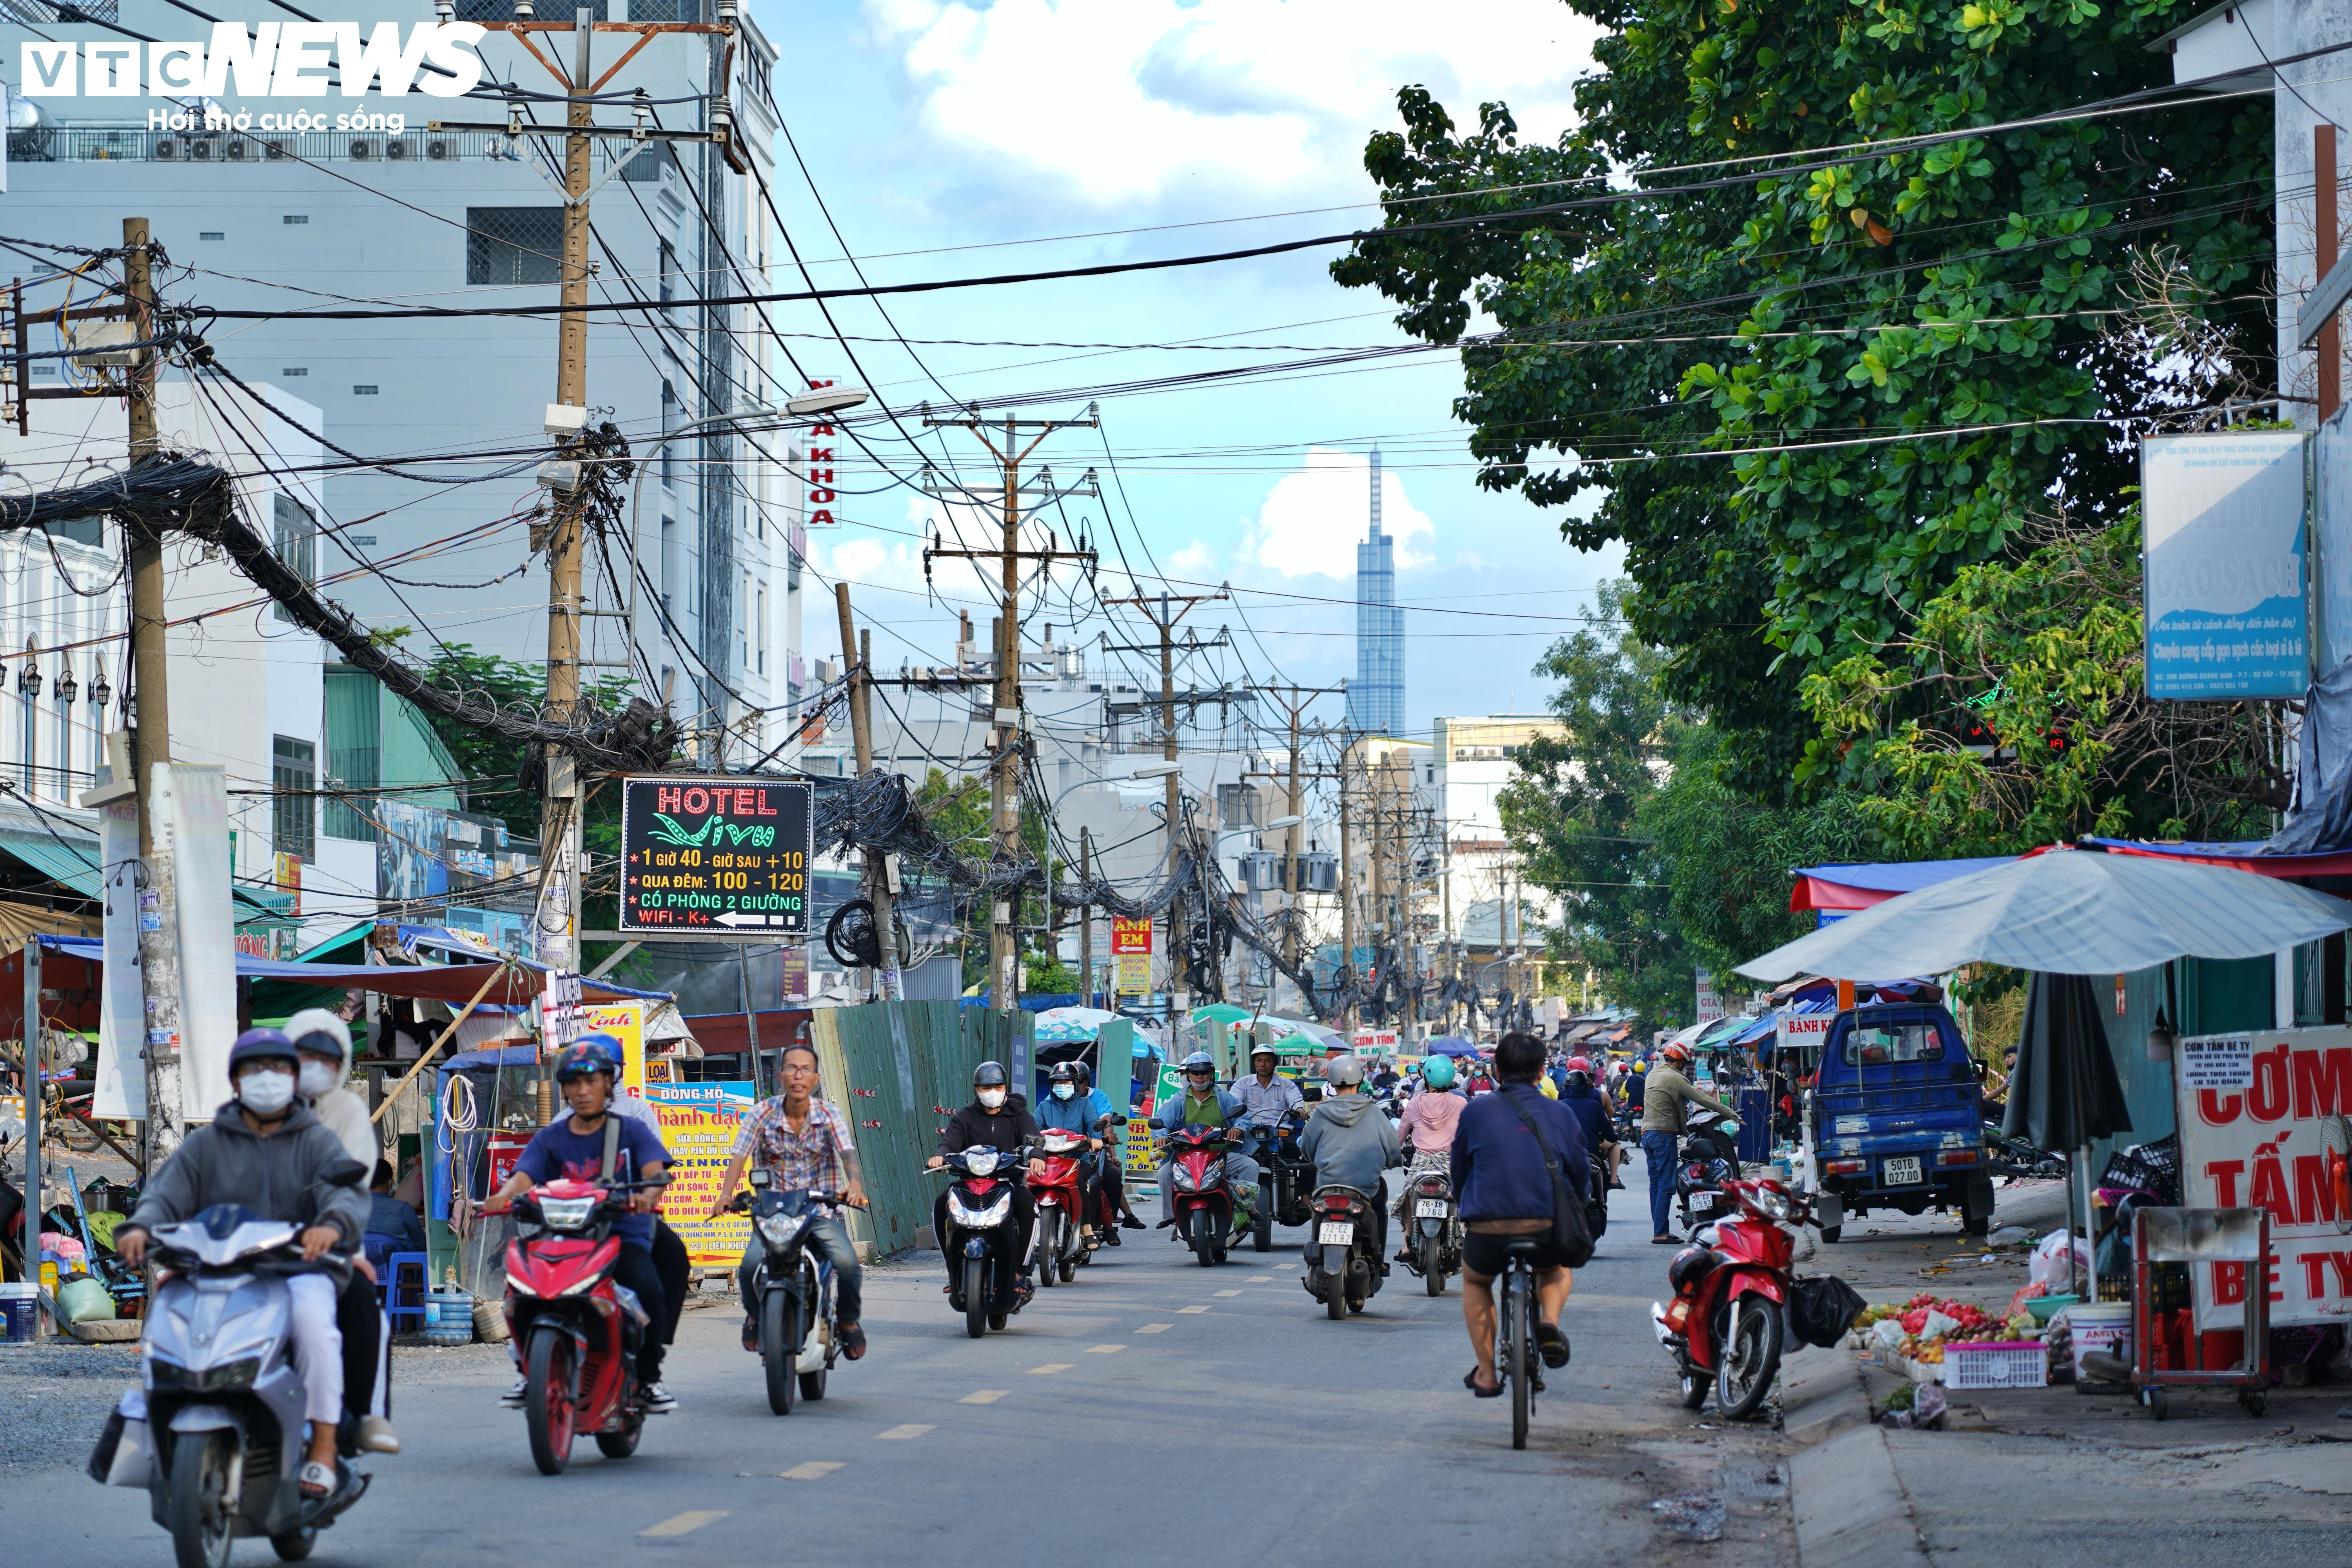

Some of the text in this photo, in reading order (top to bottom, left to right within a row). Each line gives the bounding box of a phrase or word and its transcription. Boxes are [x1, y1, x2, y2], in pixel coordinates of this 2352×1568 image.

[809, 448, 835, 524] KHOA
[2155, 554, 2301, 612] GẠO SẠCH
[658, 787, 777, 815] HOTEL
[642, 848, 651, 866] 1
[656, 851, 677, 866] GIỜ
[680, 849, 701, 867] 40
[713, 852, 733, 867] GIỜ
[737, 855, 760, 868] SAU
[642, 875, 670, 888] QUA
[673, 873, 707, 888] ĐÊM:
[712, 872, 747, 889] 100
[768, 873, 803, 890] 120
[641, 890, 801, 910] CÓ PHÒNG 2 GIƯỜNG
[639, 910, 709, 924] WIFI K+
[1114, 920, 1150, 932] ANH
[1121, 933, 1144, 945] EM
[587, 1010, 631, 1030] Linh
[1789, 1017, 1818, 1033] BÁNH
[2185, 1042, 2204, 1052] CƠM
[2227, 1040, 2238, 1051] BÉ
[2240, 1041, 2250, 1051] TY
[660, 1084, 724, 1100] ĐỒNG HỒ
[694, 1132, 717, 1143] ĐỒNG
[719, 1131, 730, 1143] HỒ
[668, 1145, 718, 1156] THAY PIN ĐỦ
[673, 1159, 733, 1167] SENKO
[1891, 1159, 1913, 1171] 50TD
[684, 1169, 699, 1180] BẾP
[701, 1170, 712, 1179] TỪ
[1889, 1171, 1918, 1183] 027.00
[677, 1183, 684, 1191] VI
[687, 1181, 709, 1191] SÓNG
[674, 1194, 692, 1203] CƠM
[700, 1194, 717, 1203] MÁY
[668, 1205, 700, 1217] ĐỒ ĐIỆN
[1325, 1224, 1348, 1234] 72-C2
[1321, 1234, 1350, 1243] 321.82
[689, 1240, 726, 1252] 223 (LIÊN
